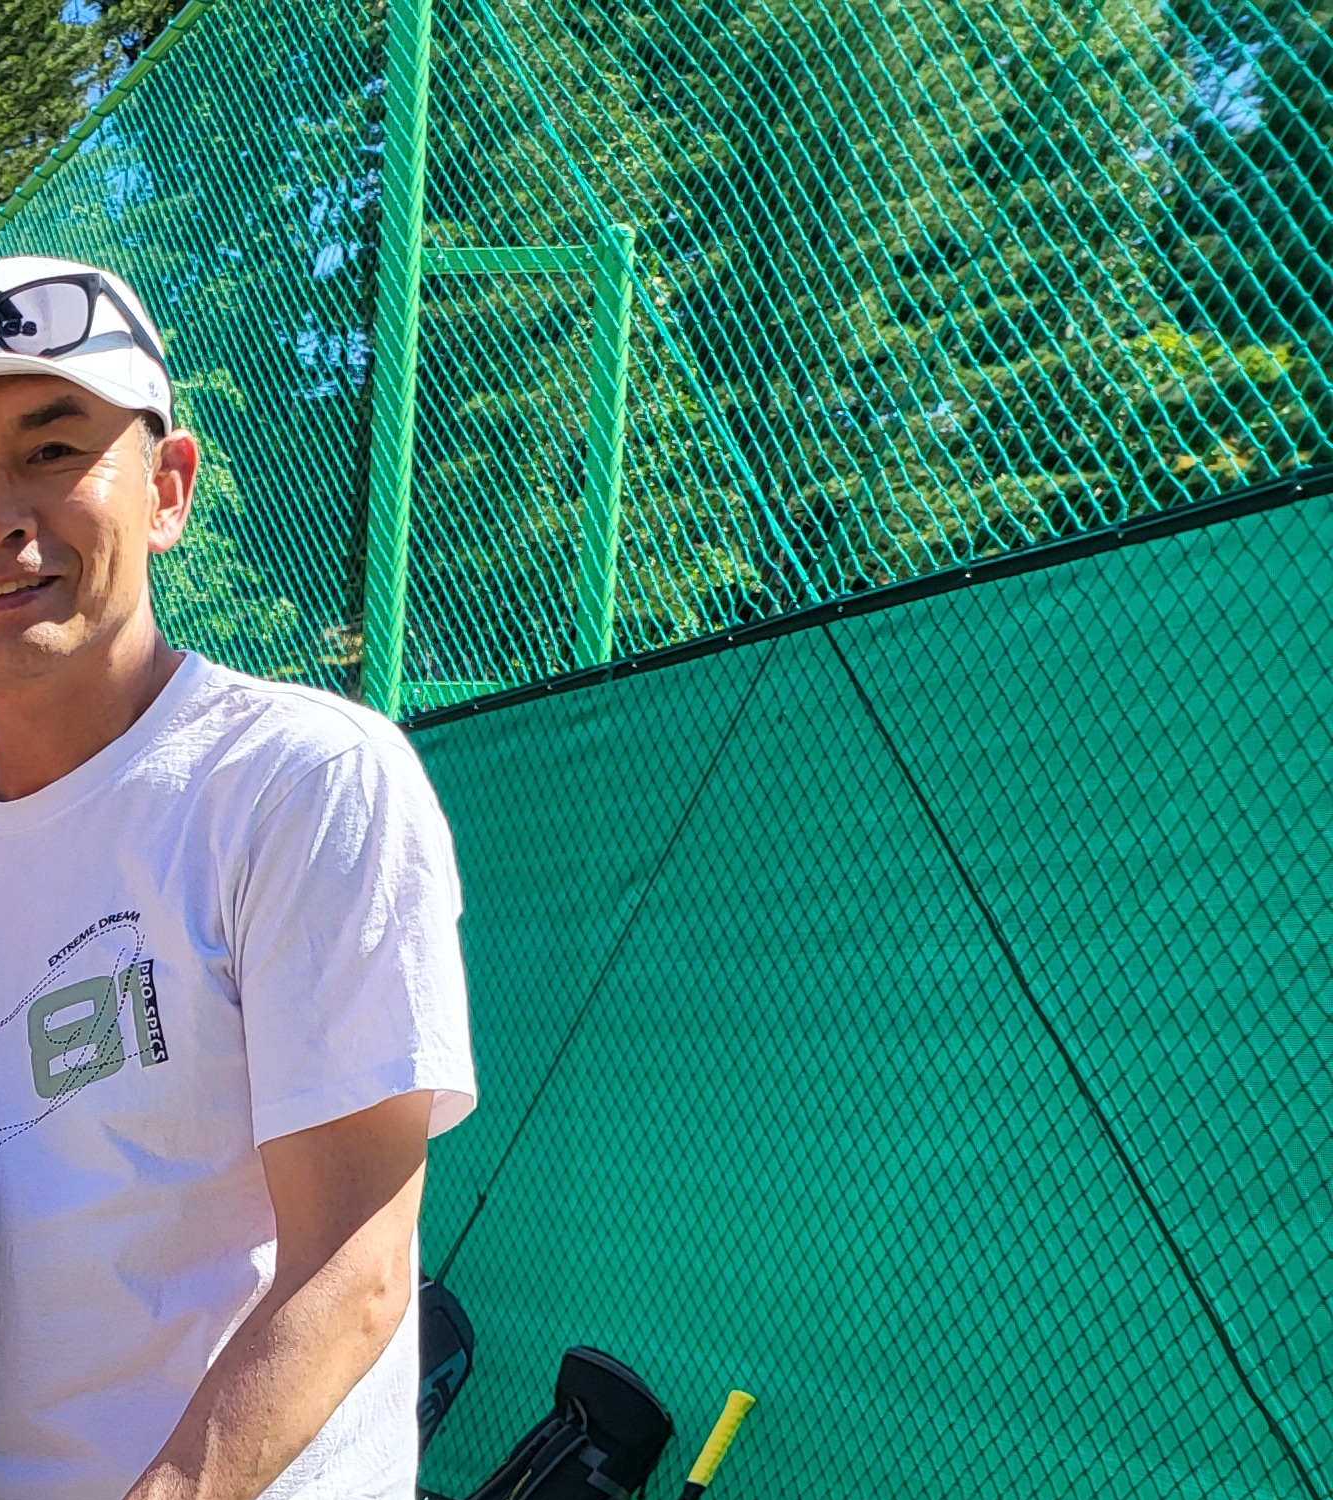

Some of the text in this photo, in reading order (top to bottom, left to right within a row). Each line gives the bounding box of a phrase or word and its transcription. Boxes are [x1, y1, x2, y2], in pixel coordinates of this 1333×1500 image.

[47, 911, 141, 967] EXTREME DREAM
[138, 962, 166, 1063] PRO-SPECS
